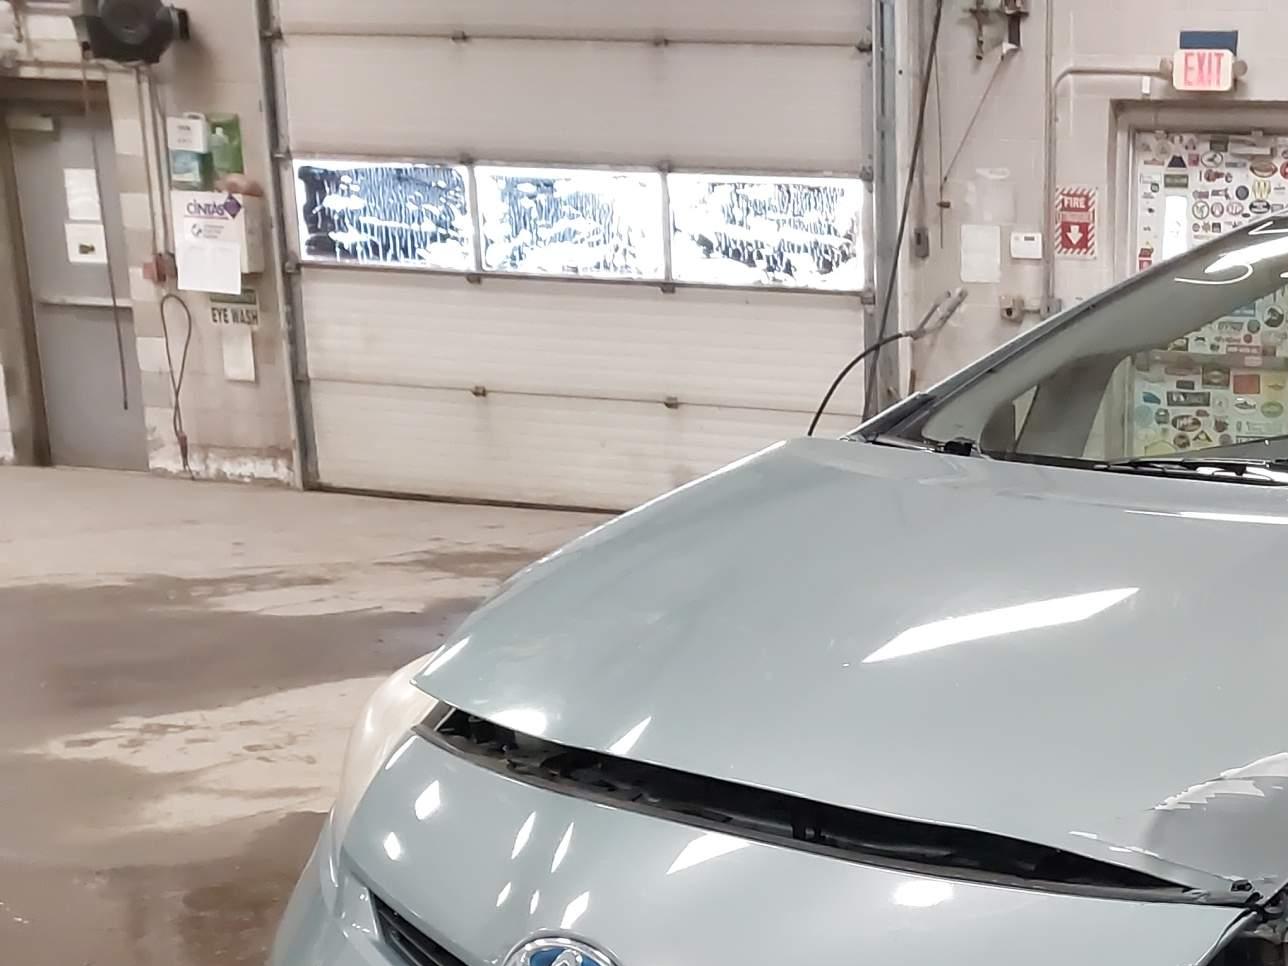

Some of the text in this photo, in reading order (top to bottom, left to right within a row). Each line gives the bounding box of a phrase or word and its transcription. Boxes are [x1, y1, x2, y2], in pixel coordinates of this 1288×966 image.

[1183, 51, 1224, 86] EXIT
[1063, 195, 1086, 209] FIRE
[211, 307, 259, 326] EYE WASH
